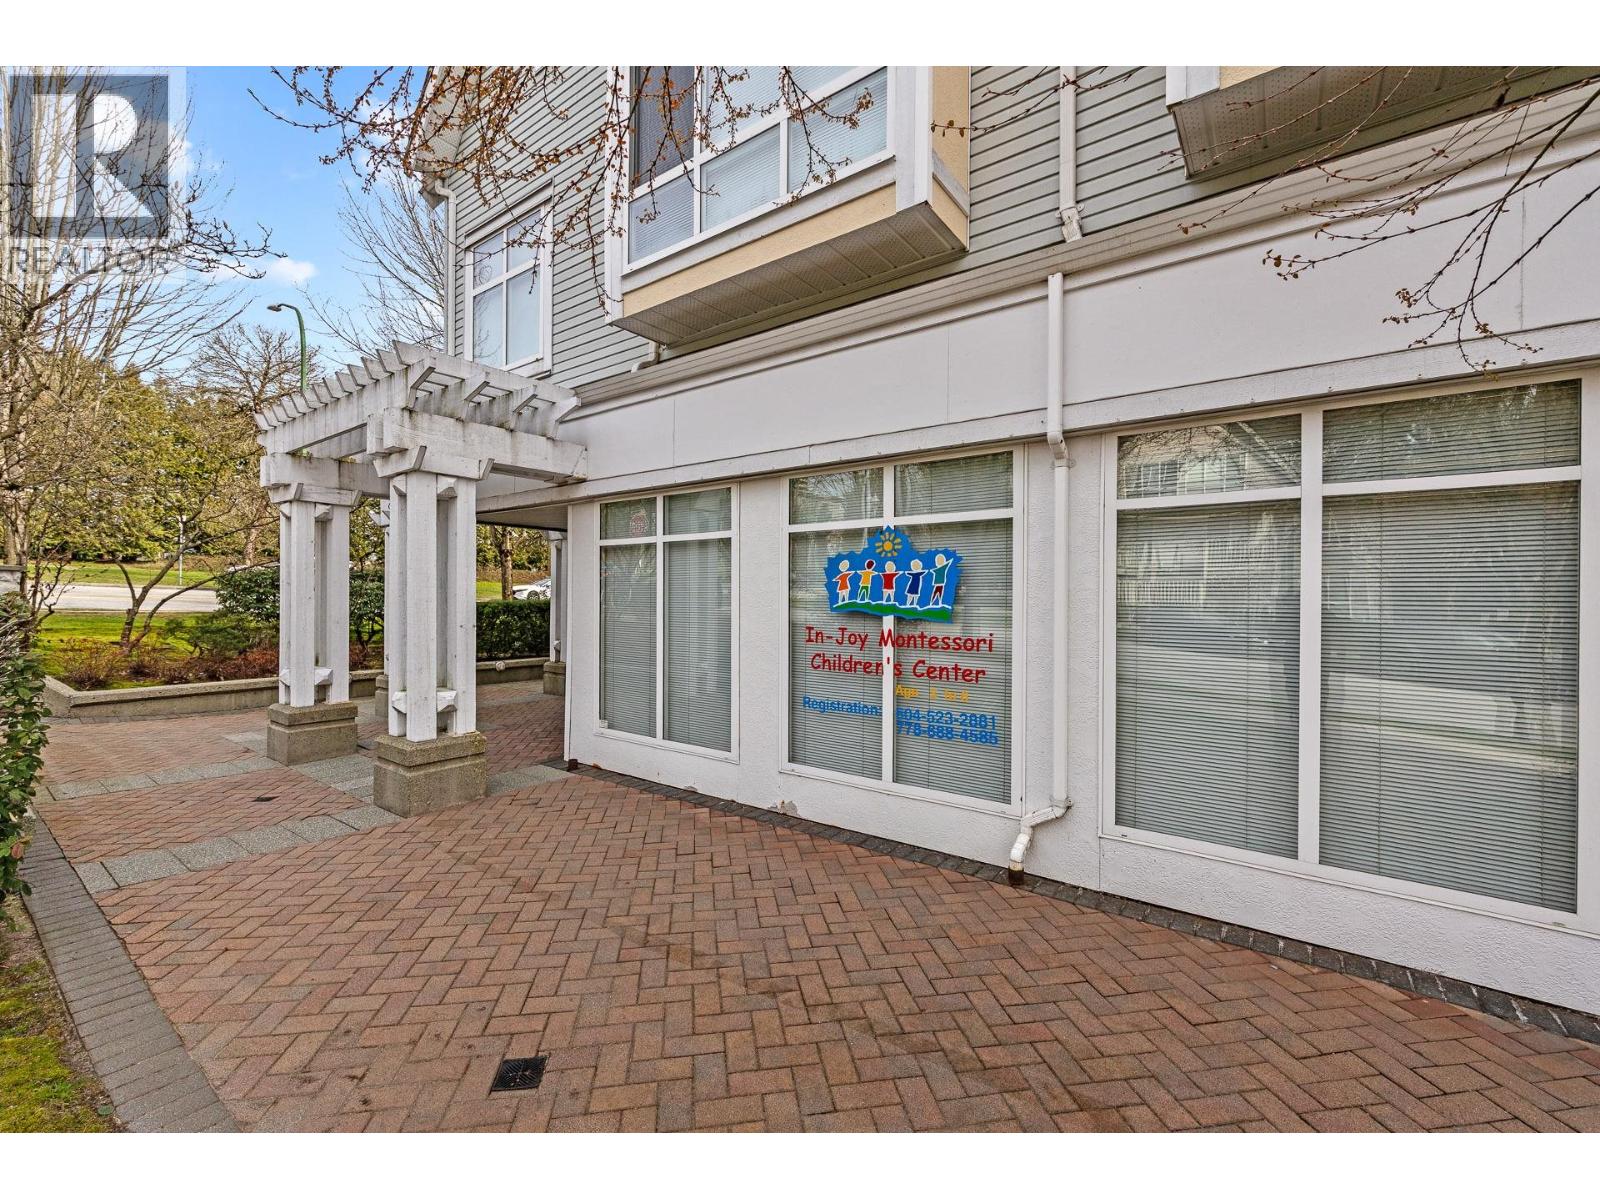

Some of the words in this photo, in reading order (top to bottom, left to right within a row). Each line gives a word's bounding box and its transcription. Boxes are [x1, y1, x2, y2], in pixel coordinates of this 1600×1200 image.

[805, 626, 869, 651] In-Joy
[879, 628, 995, 653] Montessori
[811, 653, 904, 677] Children's
[912, 660, 987, 684] Center
